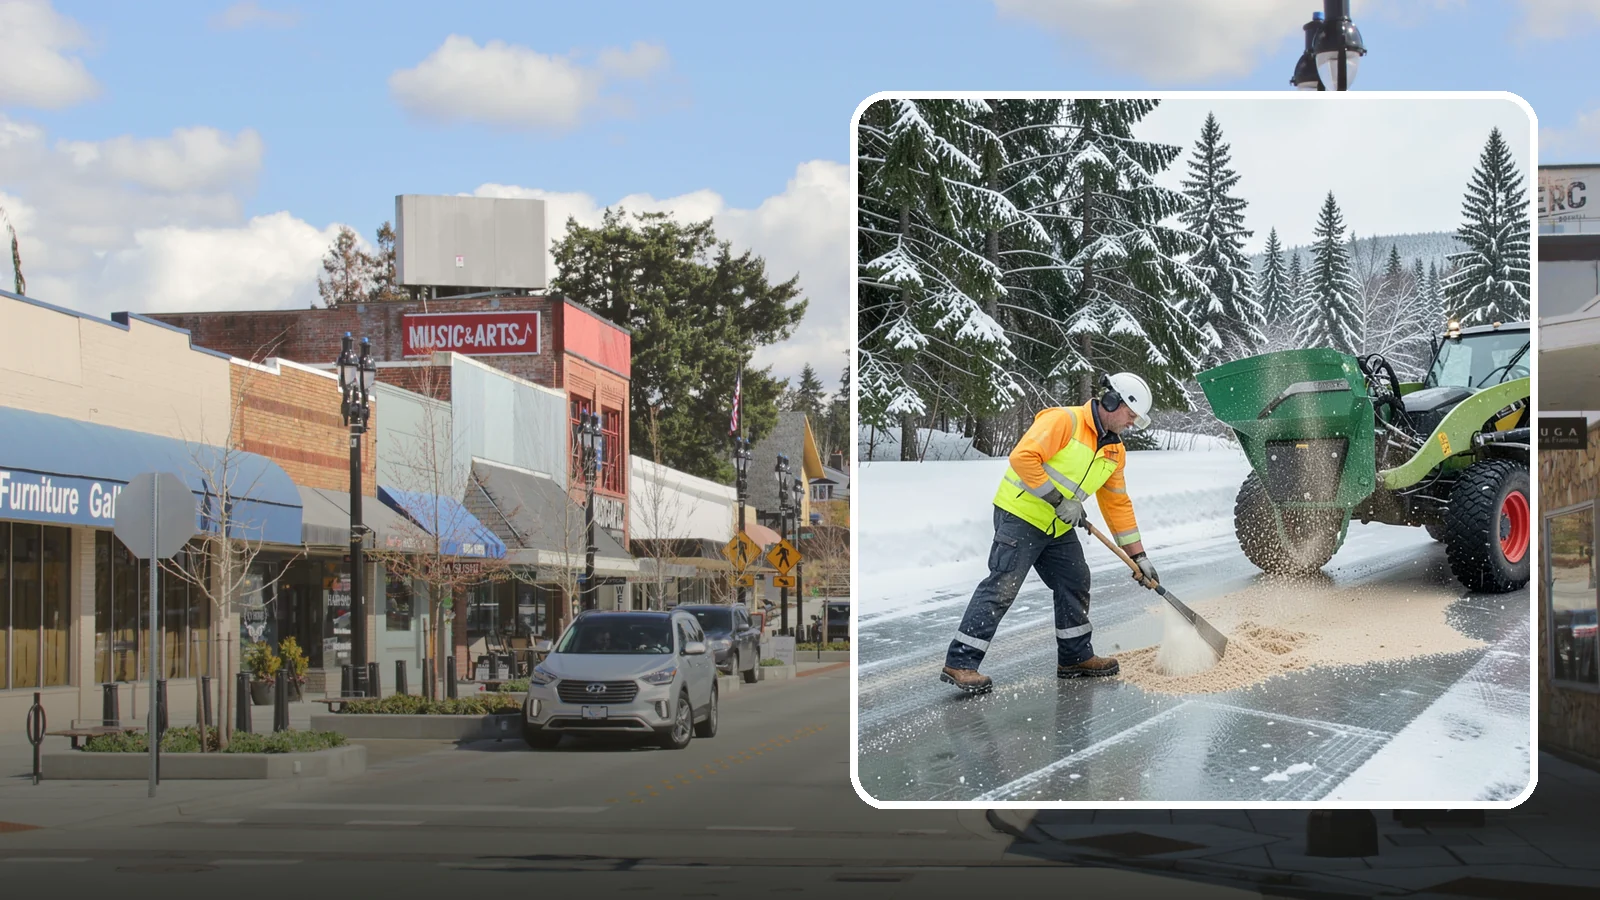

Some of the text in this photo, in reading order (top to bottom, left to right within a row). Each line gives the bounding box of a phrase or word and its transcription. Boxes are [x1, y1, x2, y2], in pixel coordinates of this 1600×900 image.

[408, 323, 519, 349] MUSIC&ARTS
[0, 471, 122, 519] Furniture Gal
